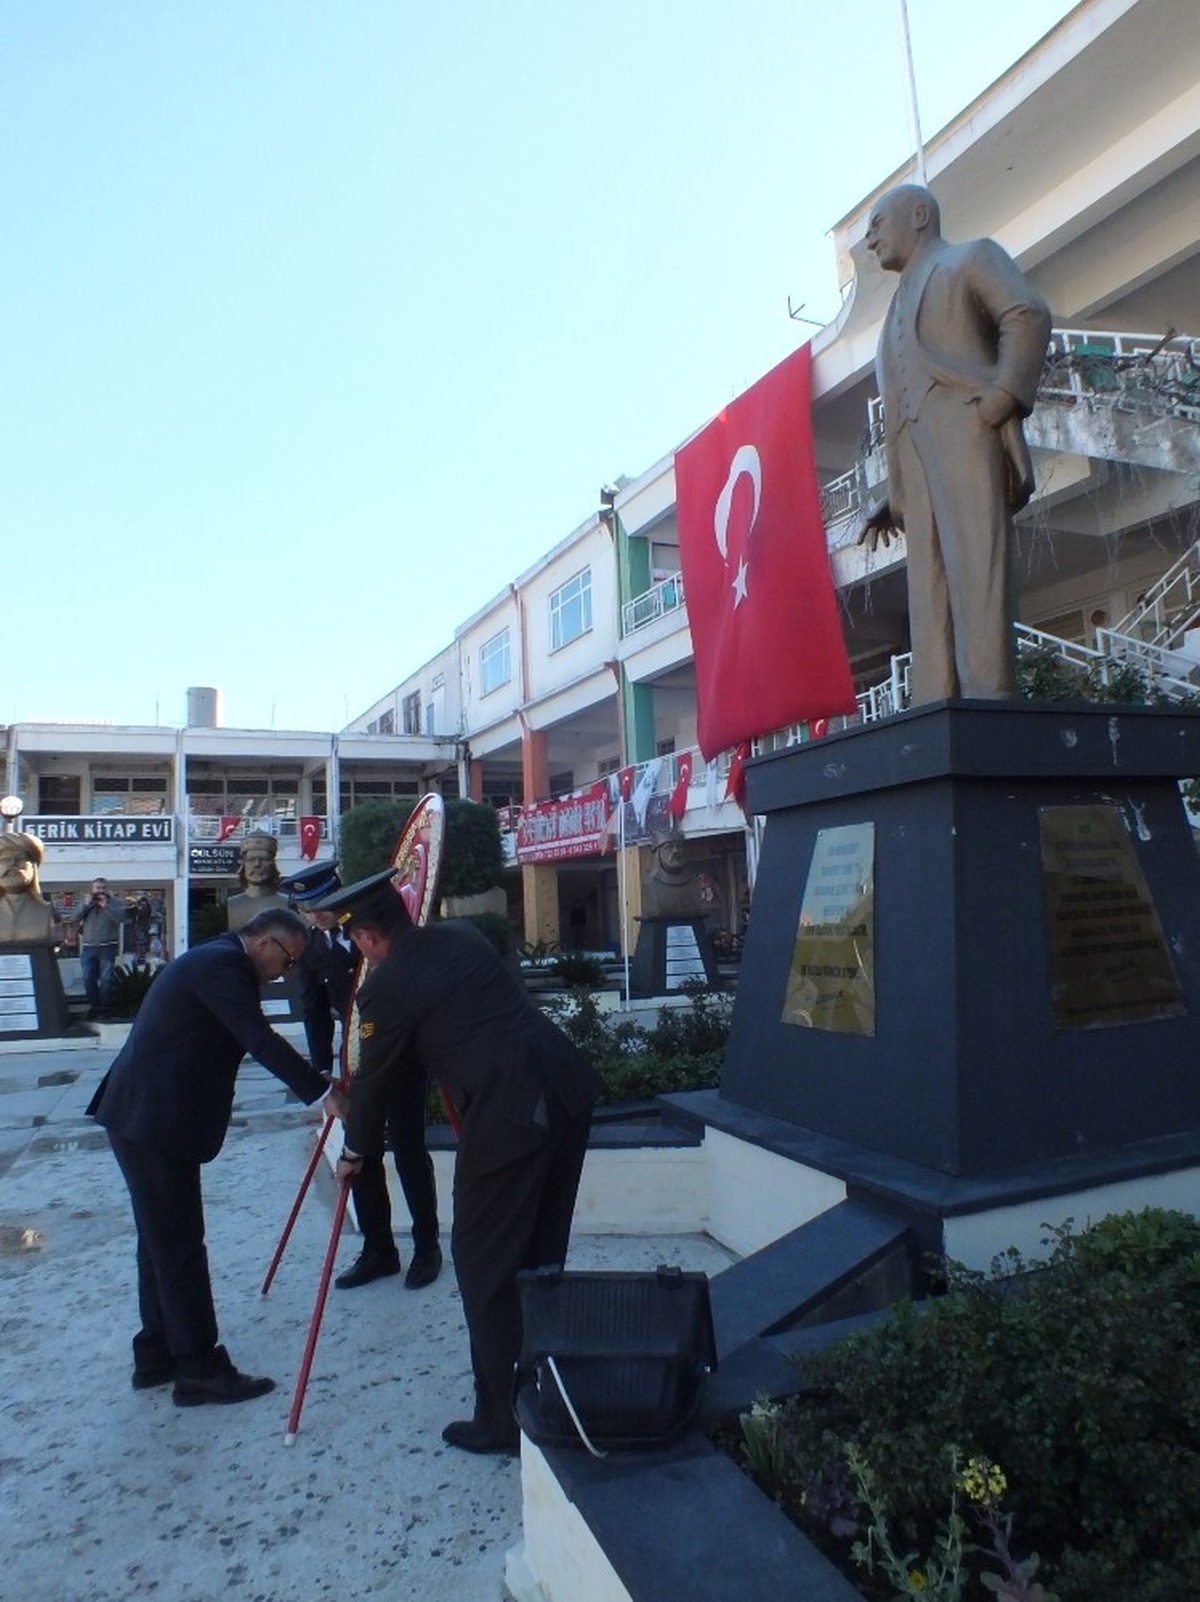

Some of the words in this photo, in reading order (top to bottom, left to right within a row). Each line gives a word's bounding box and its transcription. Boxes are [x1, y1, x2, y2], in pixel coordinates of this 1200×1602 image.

[25, 821, 78, 839] SERİK
[84, 821, 137, 839] KİTAP
[142, 821, 170, 838] EVİ
